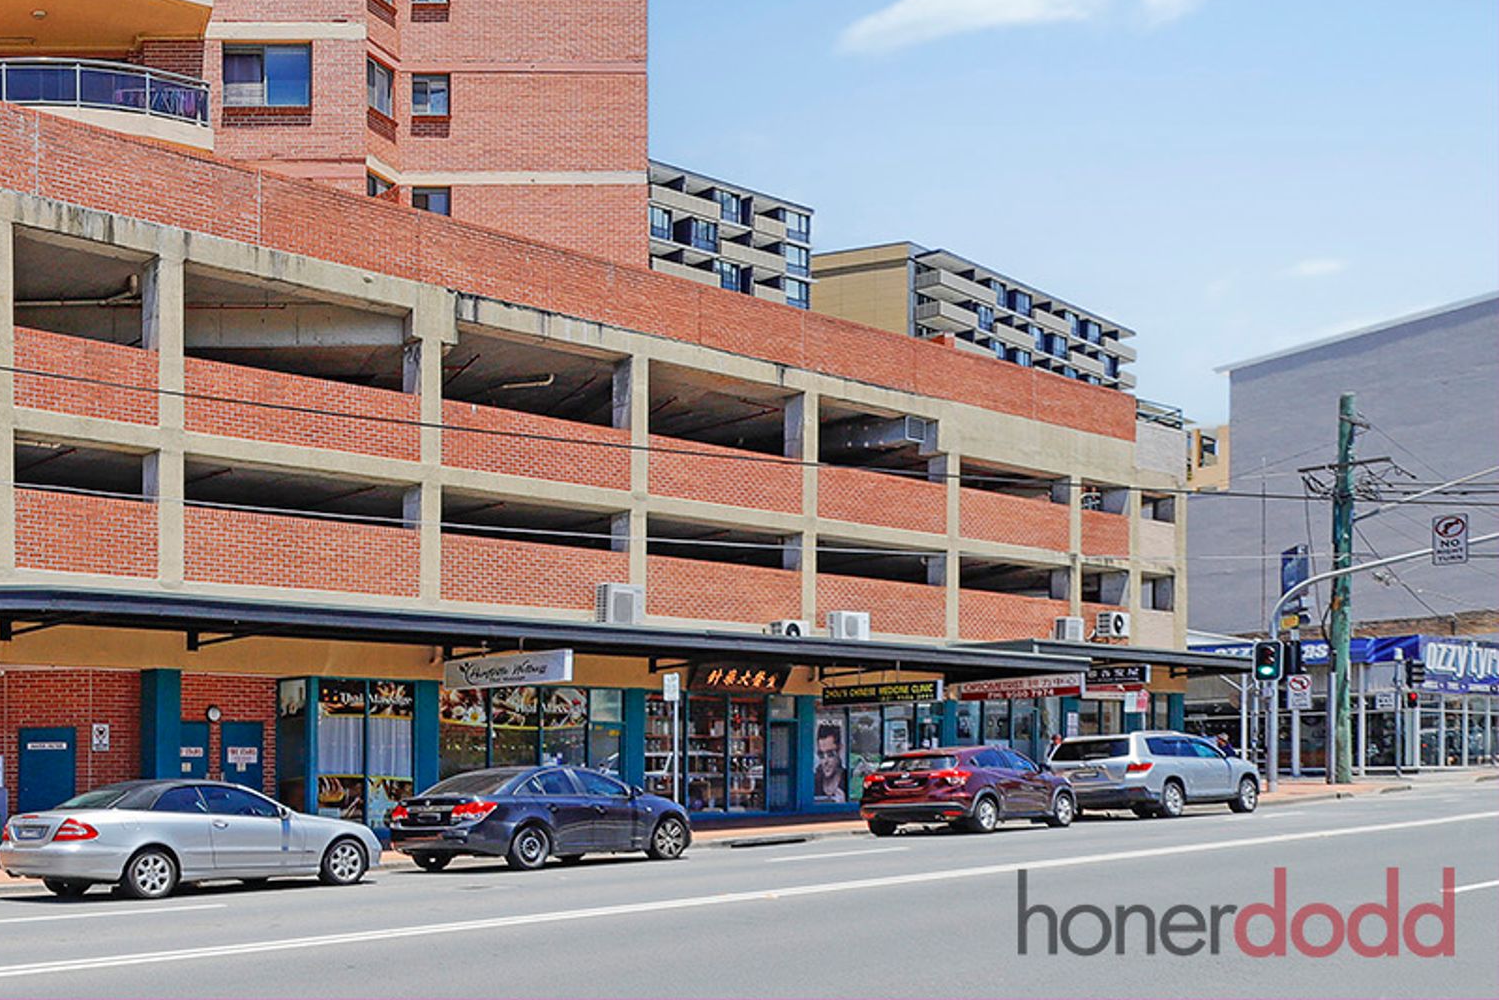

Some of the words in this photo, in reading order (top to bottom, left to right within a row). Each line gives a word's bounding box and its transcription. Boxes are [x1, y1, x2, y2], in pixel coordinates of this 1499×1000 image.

[1440, 539, 1460, 548] NO
[849, 687, 876, 697] CHINESE
[878, 685, 909, 695] MEDICINE
[911, 683, 934, 693] CLINIC
